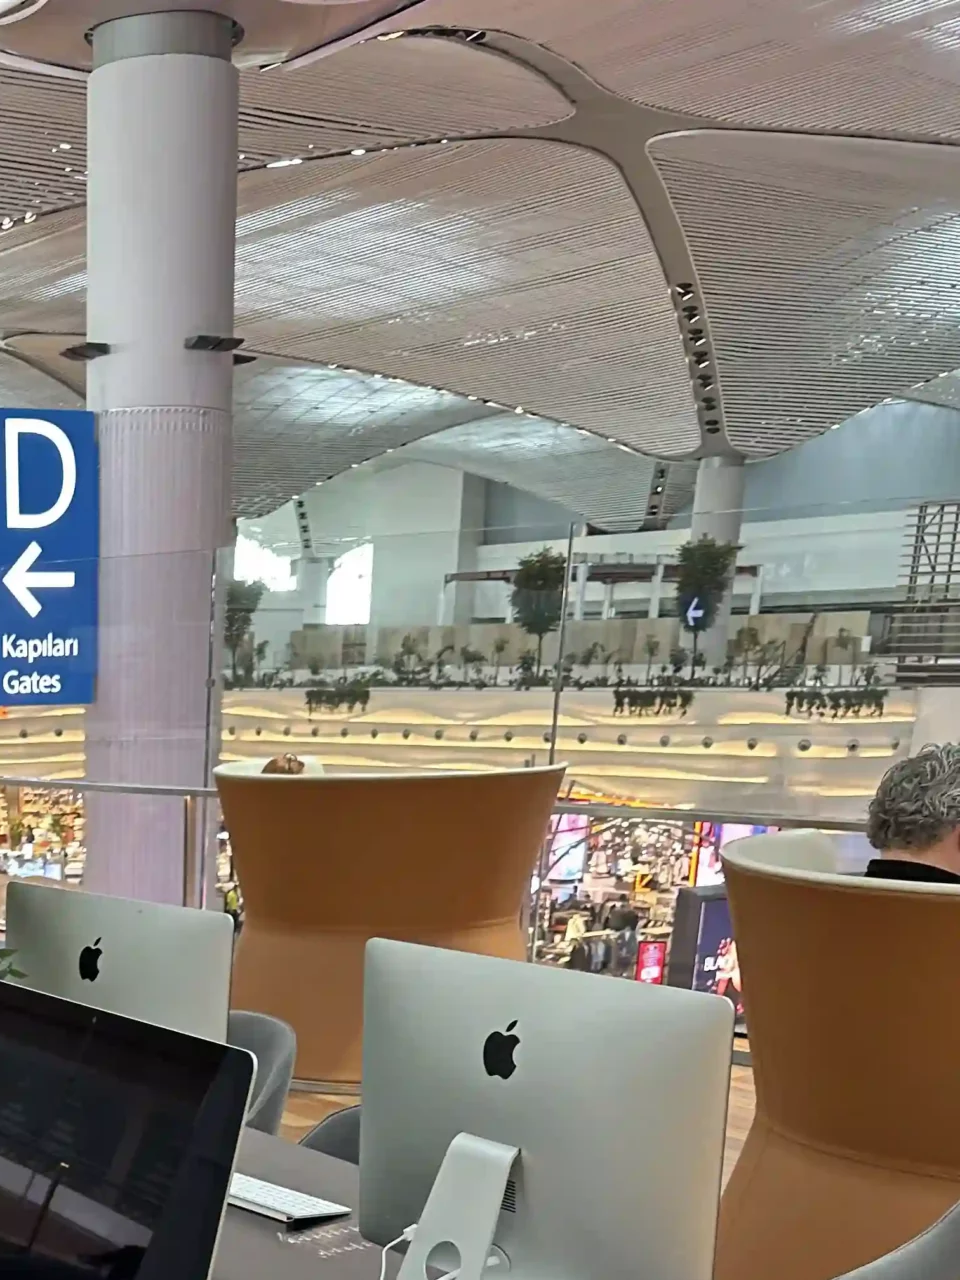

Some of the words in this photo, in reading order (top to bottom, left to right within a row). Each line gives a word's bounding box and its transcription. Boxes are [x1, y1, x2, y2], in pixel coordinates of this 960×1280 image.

[4, 417, 77, 529] D
[2, 632, 78, 663] Kapıları
[2, 671, 61, 694] Gates
